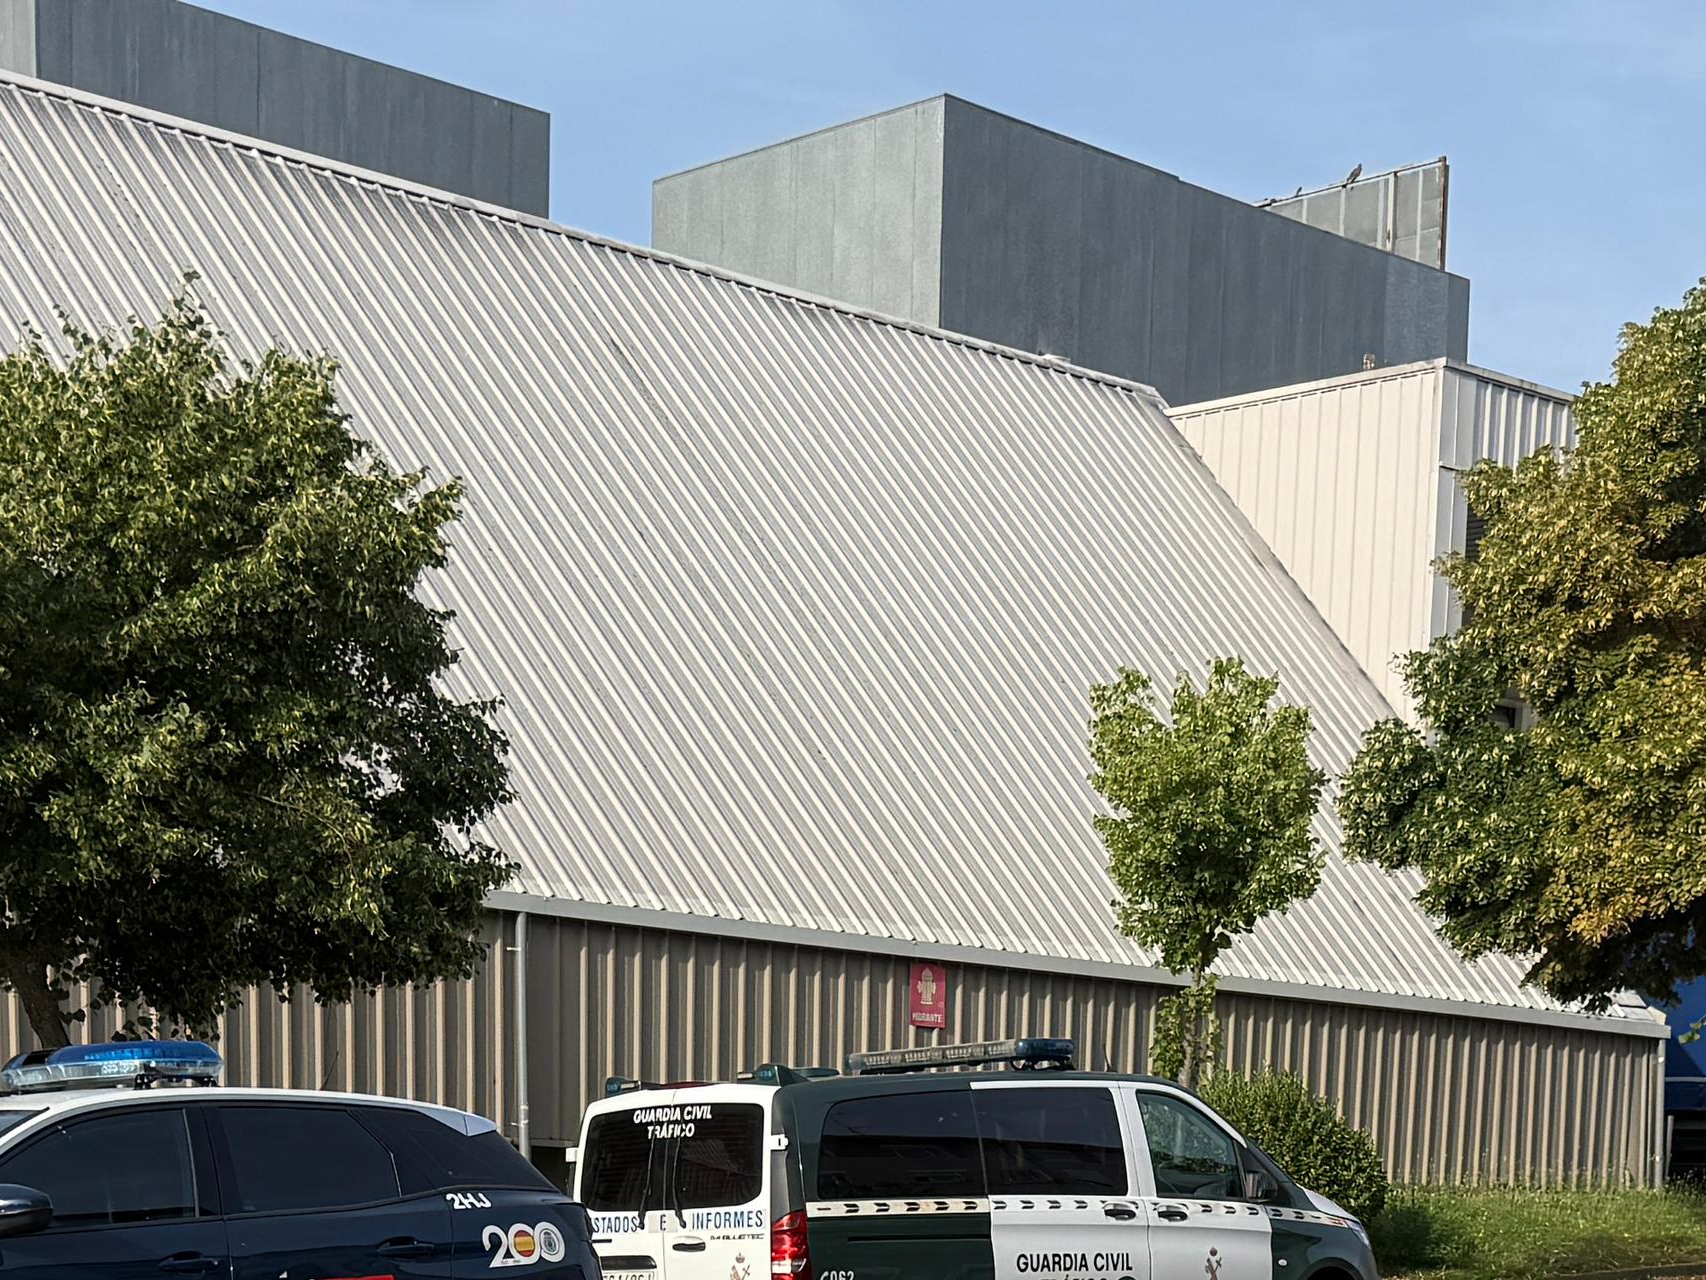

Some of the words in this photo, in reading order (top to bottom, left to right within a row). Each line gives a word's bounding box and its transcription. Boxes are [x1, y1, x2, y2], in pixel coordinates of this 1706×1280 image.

[633, 1106, 682, 1123] GUARDIA
[683, 1105, 713, 1120] CIVIL
[692, 1210, 763, 1230] INFORMES
[481, 1221, 566, 1268] 200
[1016, 1253, 1089, 1273] GUARDIA
[1093, 1252, 1133, 1272] CIVIL
